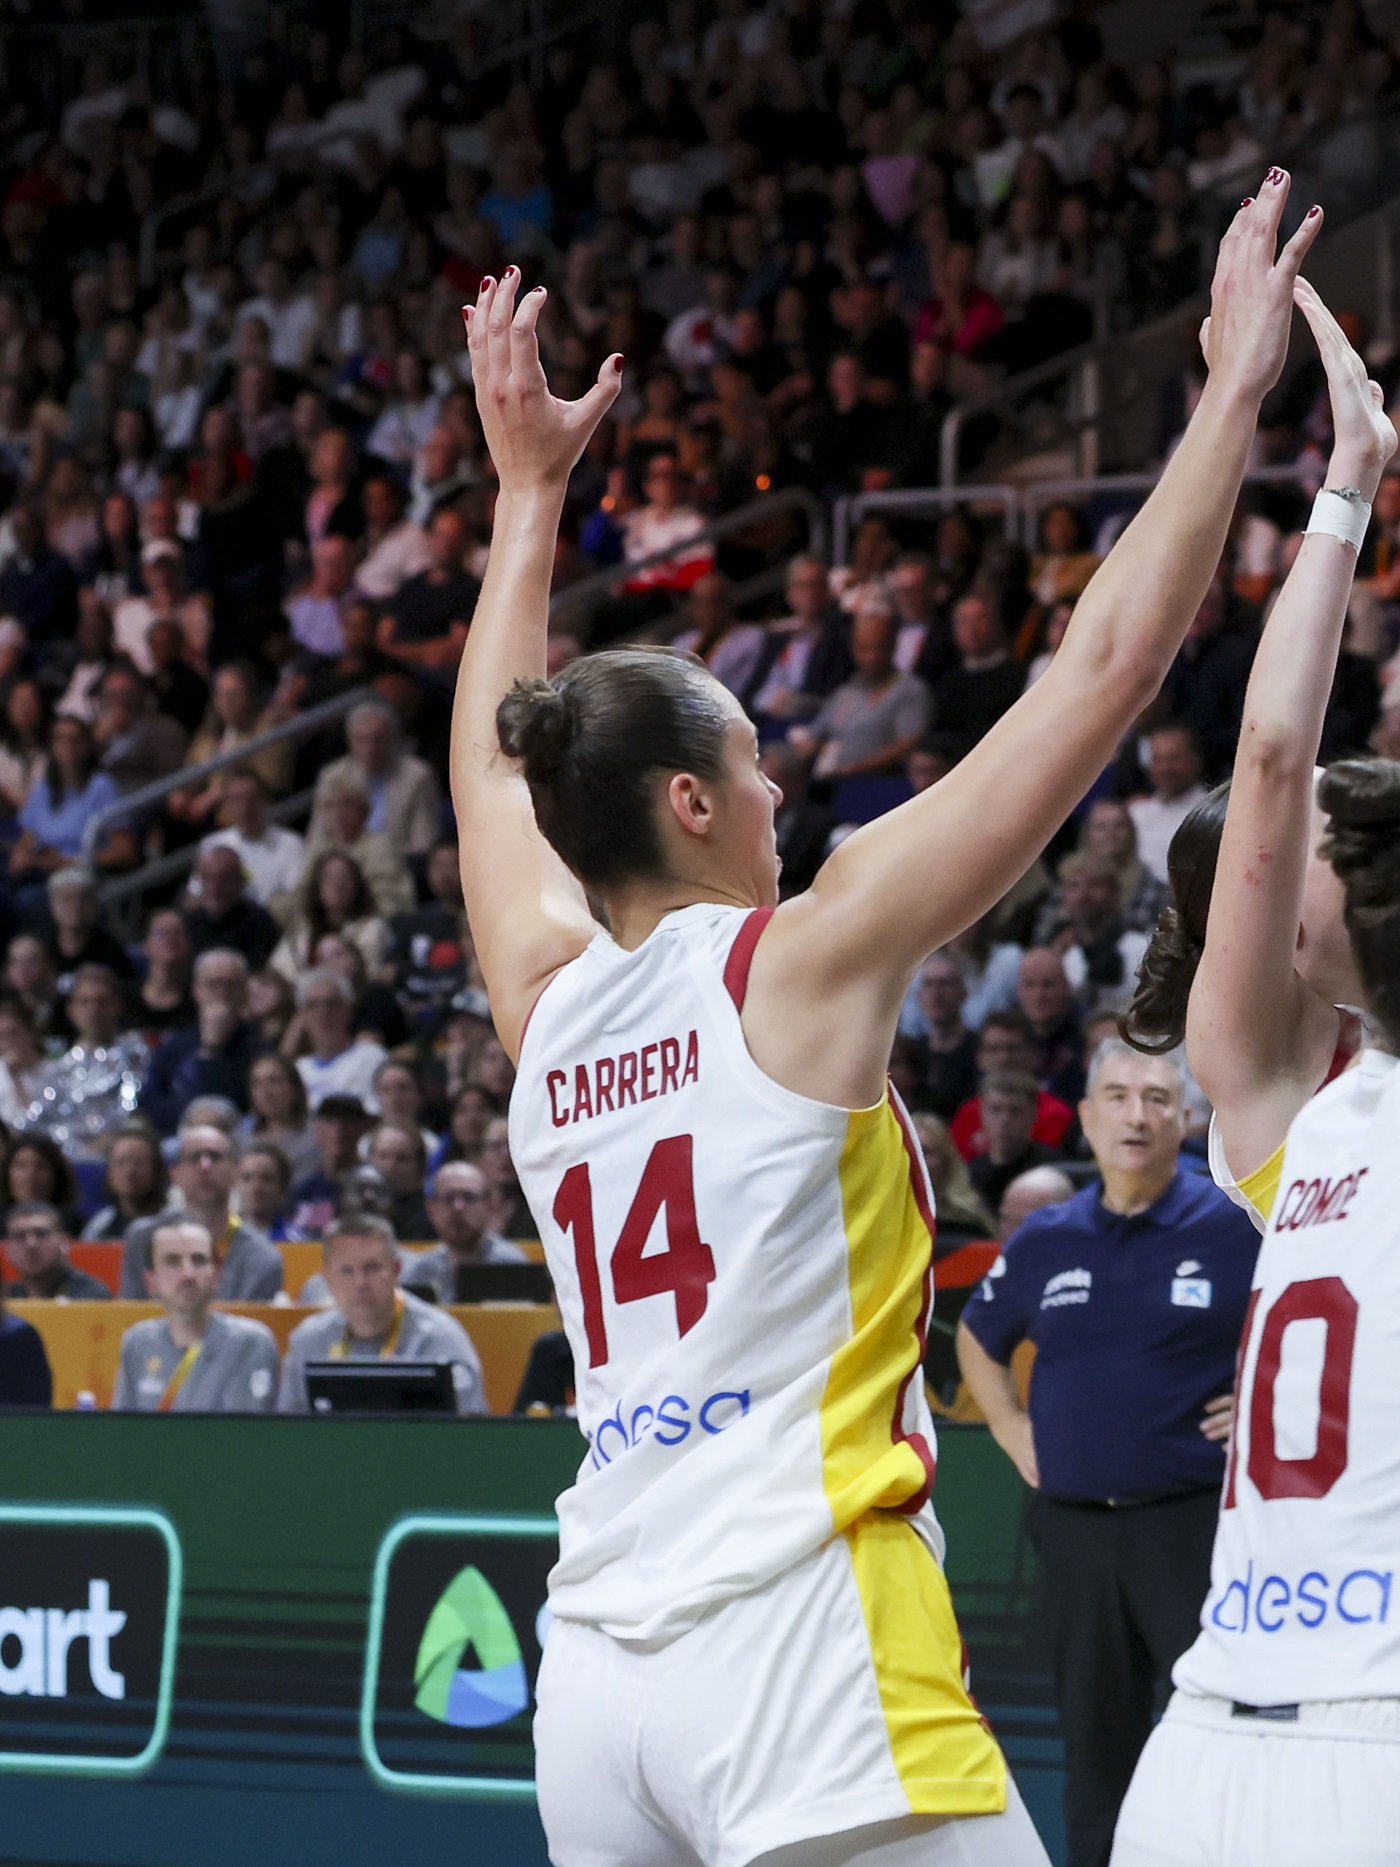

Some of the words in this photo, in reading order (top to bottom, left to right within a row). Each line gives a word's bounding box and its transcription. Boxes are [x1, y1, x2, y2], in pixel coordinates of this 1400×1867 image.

[546, 1029, 699, 1128] CARRERA
[552, 1133, 716, 1369] 14
[0, 1578, 128, 1700] art
